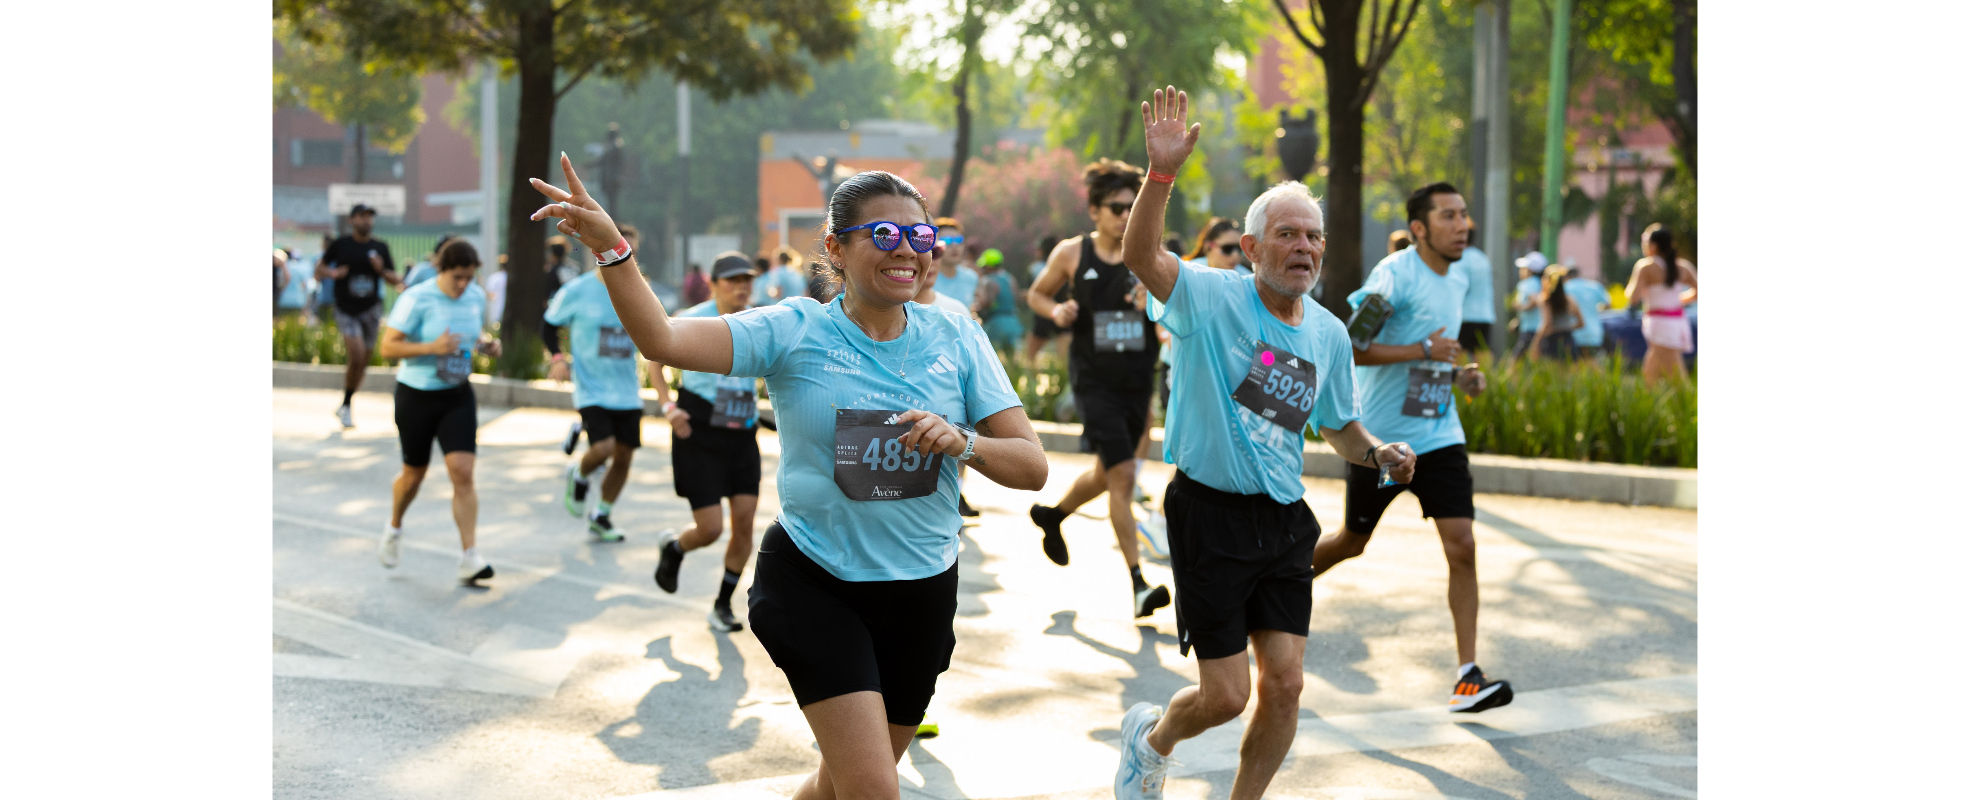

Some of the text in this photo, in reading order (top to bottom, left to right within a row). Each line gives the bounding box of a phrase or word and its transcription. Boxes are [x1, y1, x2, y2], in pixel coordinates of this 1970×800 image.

[823, 364, 861, 376] SAMSUNG
[1263, 368, 1314, 413] 5926
[860, 392, 926, 410] CDMX CDMX
